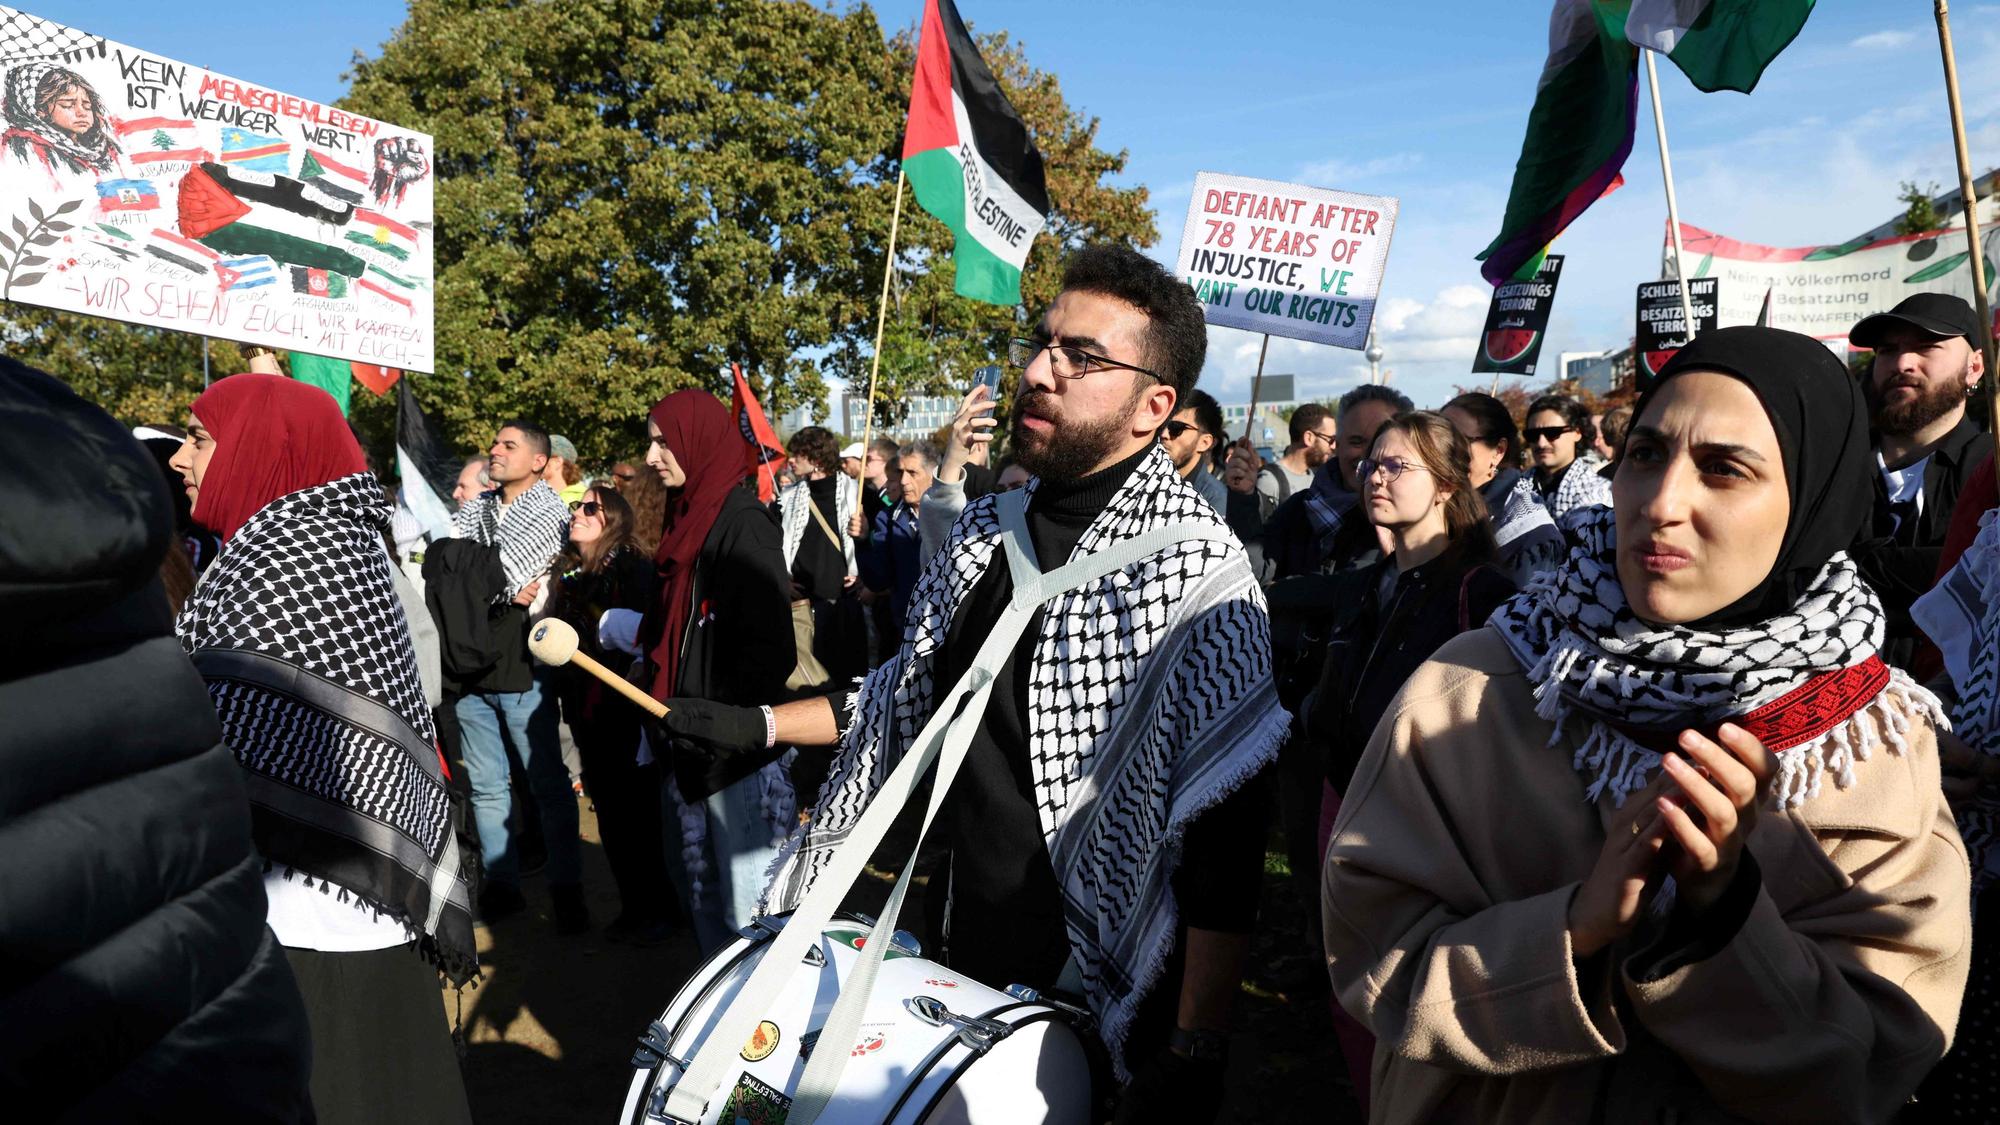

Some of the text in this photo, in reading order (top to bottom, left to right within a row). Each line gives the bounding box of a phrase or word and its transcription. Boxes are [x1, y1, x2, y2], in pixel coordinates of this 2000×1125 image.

[114, 49, 187, 88] KEIN
[127, 83, 361, 154] IST WENIGER WERT.
[959, 142, 1027, 248] FREE PALESTINE
[111, 213, 149, 226] HAITI
[1203, 188, 1380, 236] DEFIANT AFTER
[1203, 219, 1362, 265] 78 YEARS OF
[144, 260, 195, 281] YEMEN
[1190, 248, 1354, 296] INJUSTICE, WE
[1728, 269, 1759, 283] Nein
[1786, 267, 1892, 287] Völkermord
[1641, 281, 1716, 299] SCHLUS MIT
[1743, 292, 1870, 305] un Besatzung
[140, 282, 231, 326] SEHEN
[291, 296, 359, 313] AFGHANISTAN
[1244, 287, 1285, 316] OUR
[1287, 291, 1360, 328] RIGHTS
[1499, 298, 1538, 312] TERROR!
[1640, 304, 1714, 322] BESATZNGS
[318, 312, 424, 344] WIR KÄMPFEN
[1650, 318, 1702, 334] TERRO!
[1801, 312, 1864, 323] WAFFEN
[316, 332, 350, 351] MIT
[742, 1075, 783, 1104] PALESTINE
